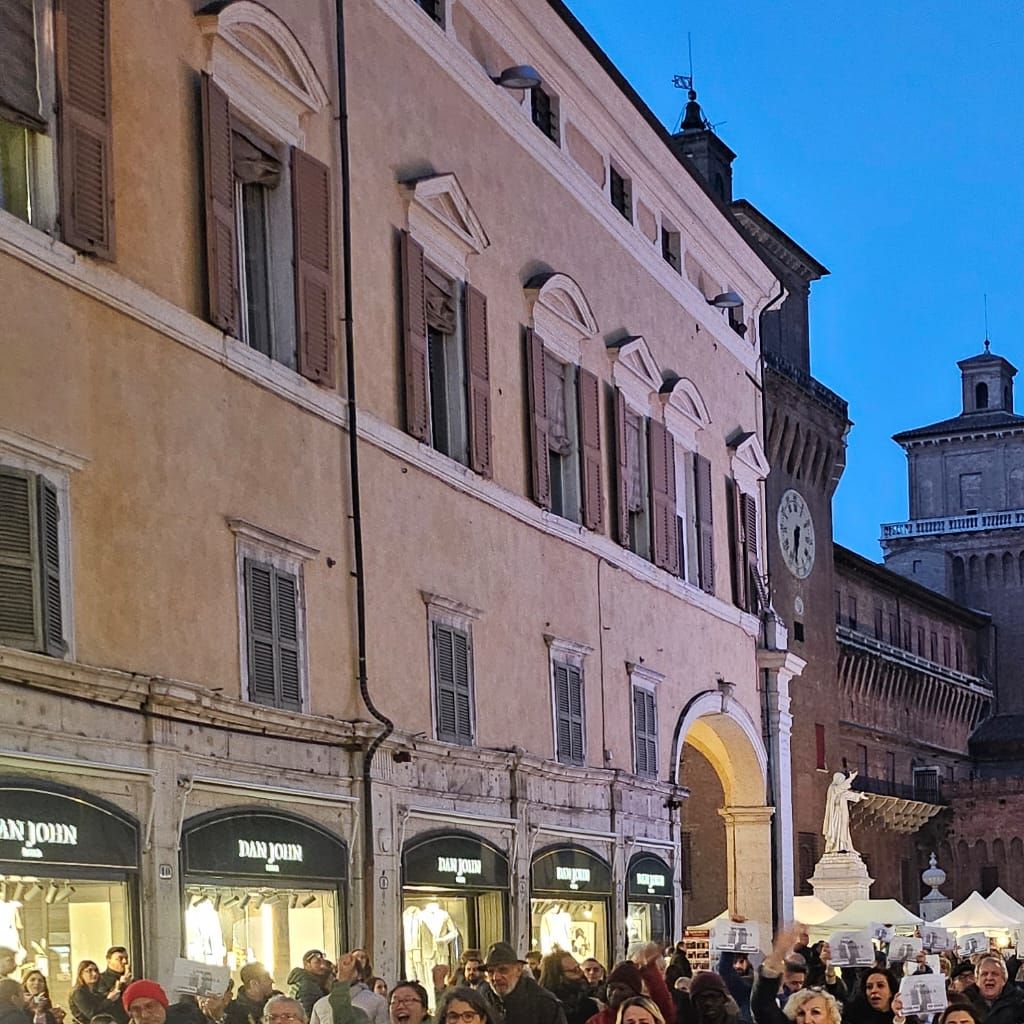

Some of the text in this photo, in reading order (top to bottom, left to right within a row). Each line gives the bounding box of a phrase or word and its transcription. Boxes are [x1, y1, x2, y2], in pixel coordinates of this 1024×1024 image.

[25, 820, 78, 847] JOHN
[238, 839, 303, 864] DAN JOHN
